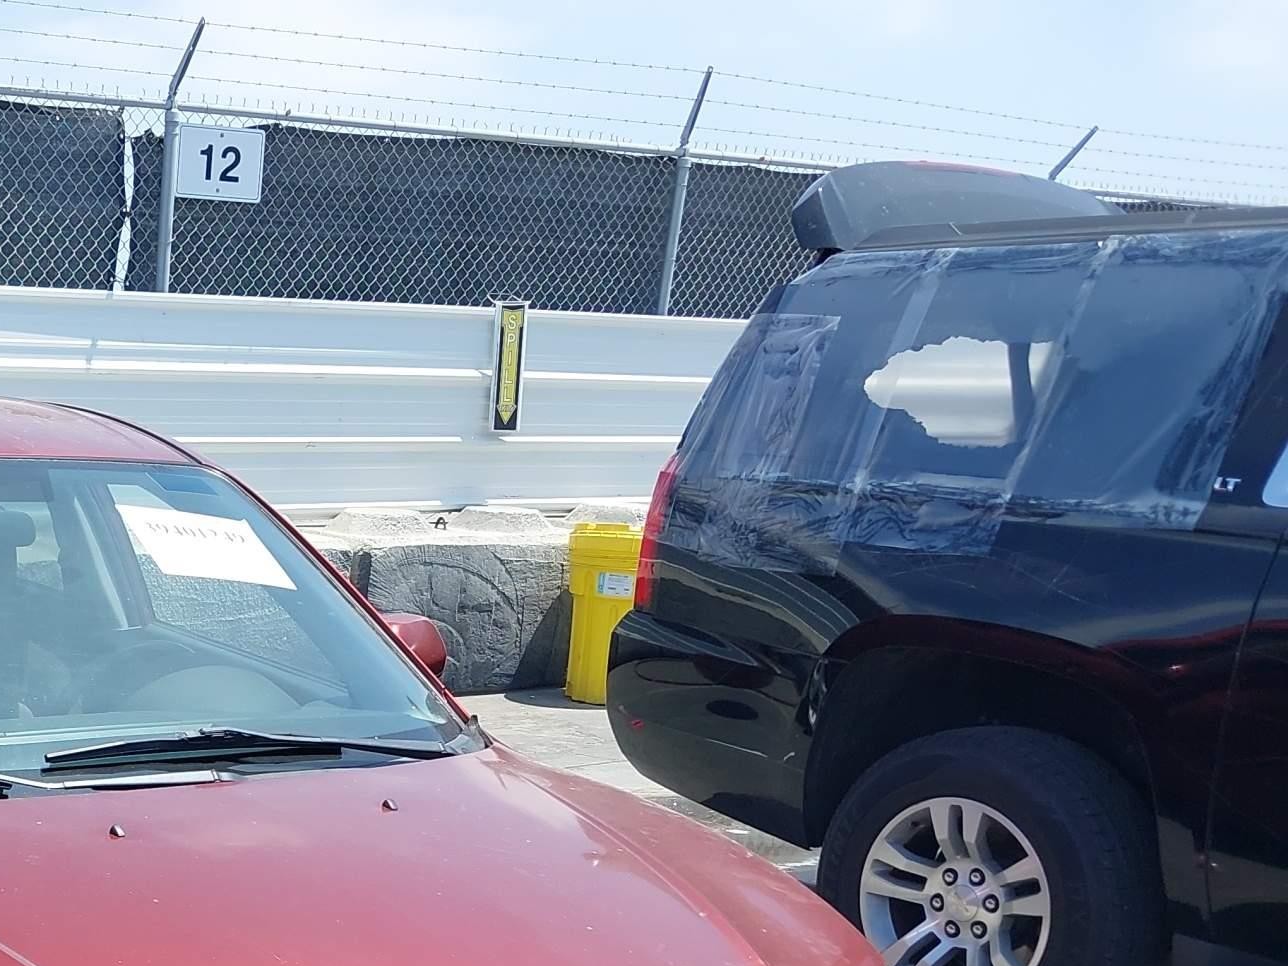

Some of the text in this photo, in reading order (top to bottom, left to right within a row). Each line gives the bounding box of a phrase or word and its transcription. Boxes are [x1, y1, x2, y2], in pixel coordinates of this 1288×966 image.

[200, 143, 242, 183] 12
[503, 314, 517, 402] SPILL
[1213, 476, 1242, 492] LT
